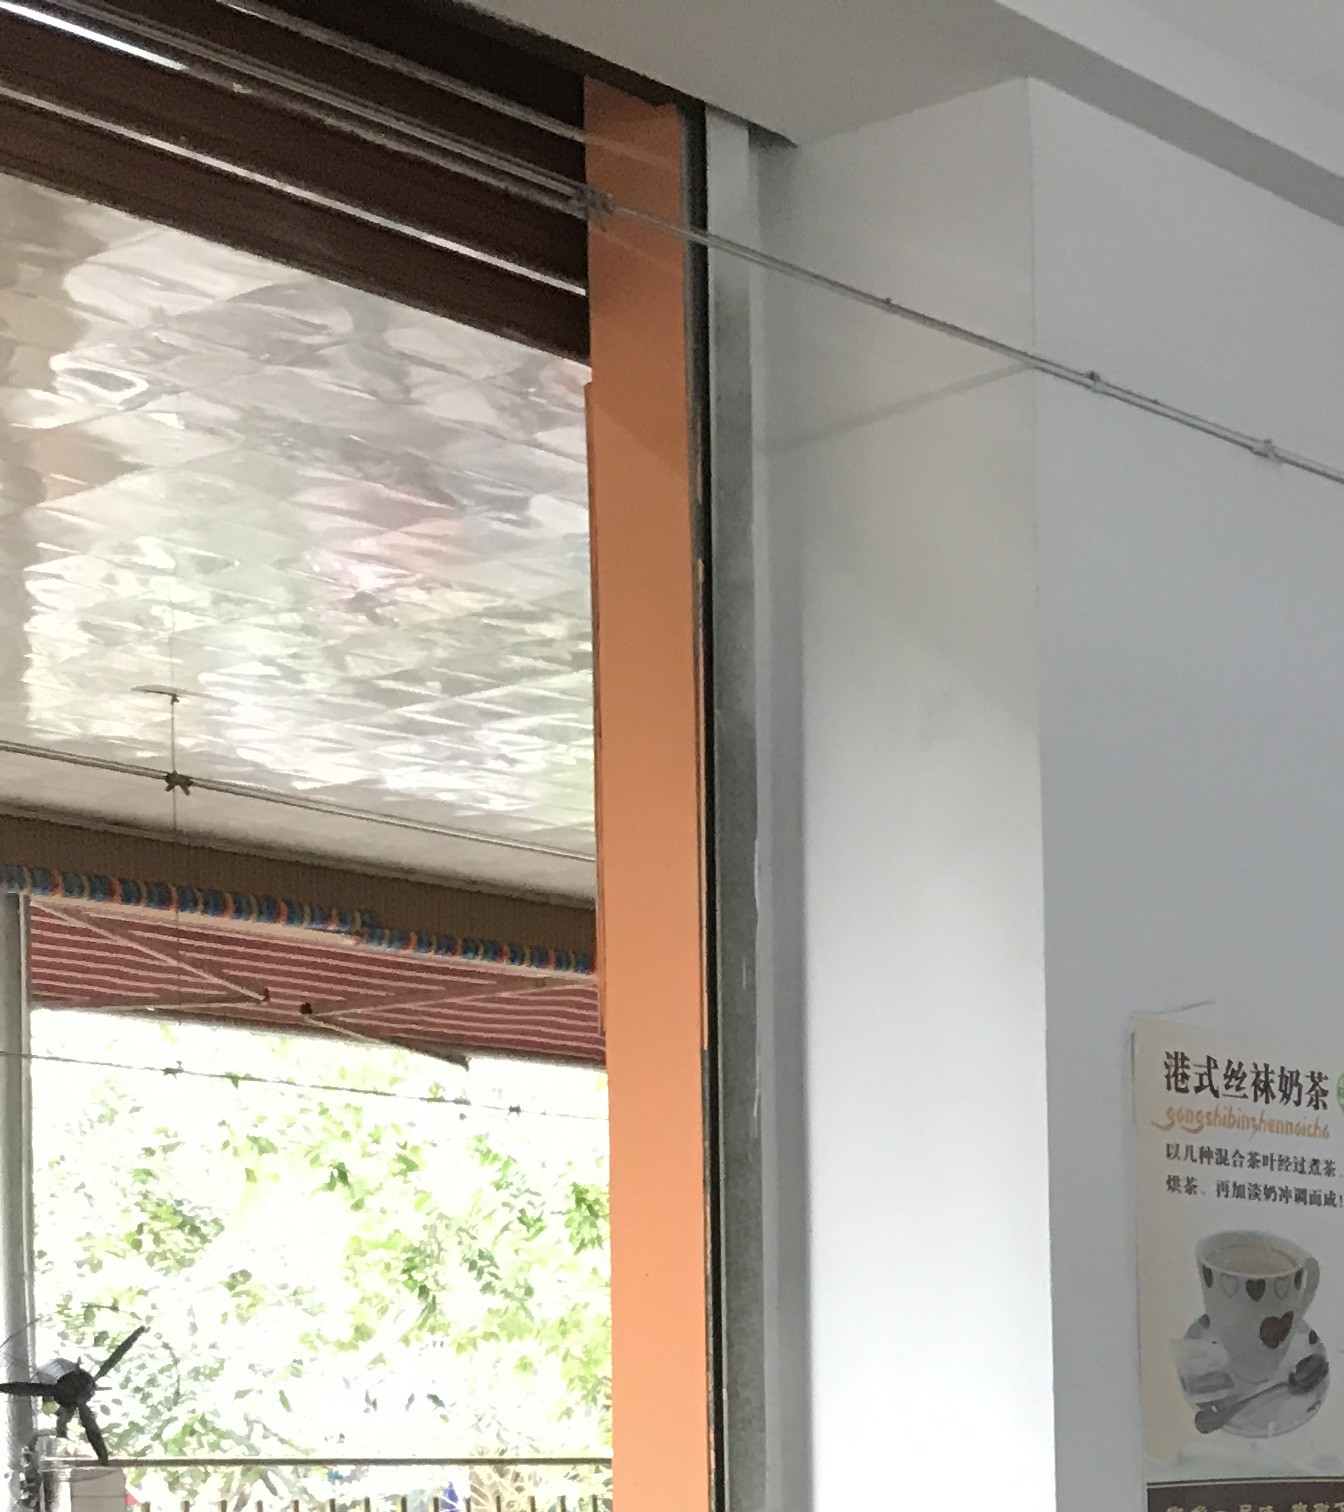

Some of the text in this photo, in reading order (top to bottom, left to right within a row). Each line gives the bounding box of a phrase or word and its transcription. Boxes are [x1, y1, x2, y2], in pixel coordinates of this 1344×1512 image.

[1164, 1050, 1329, 1111] 港式丝袜奶茶
